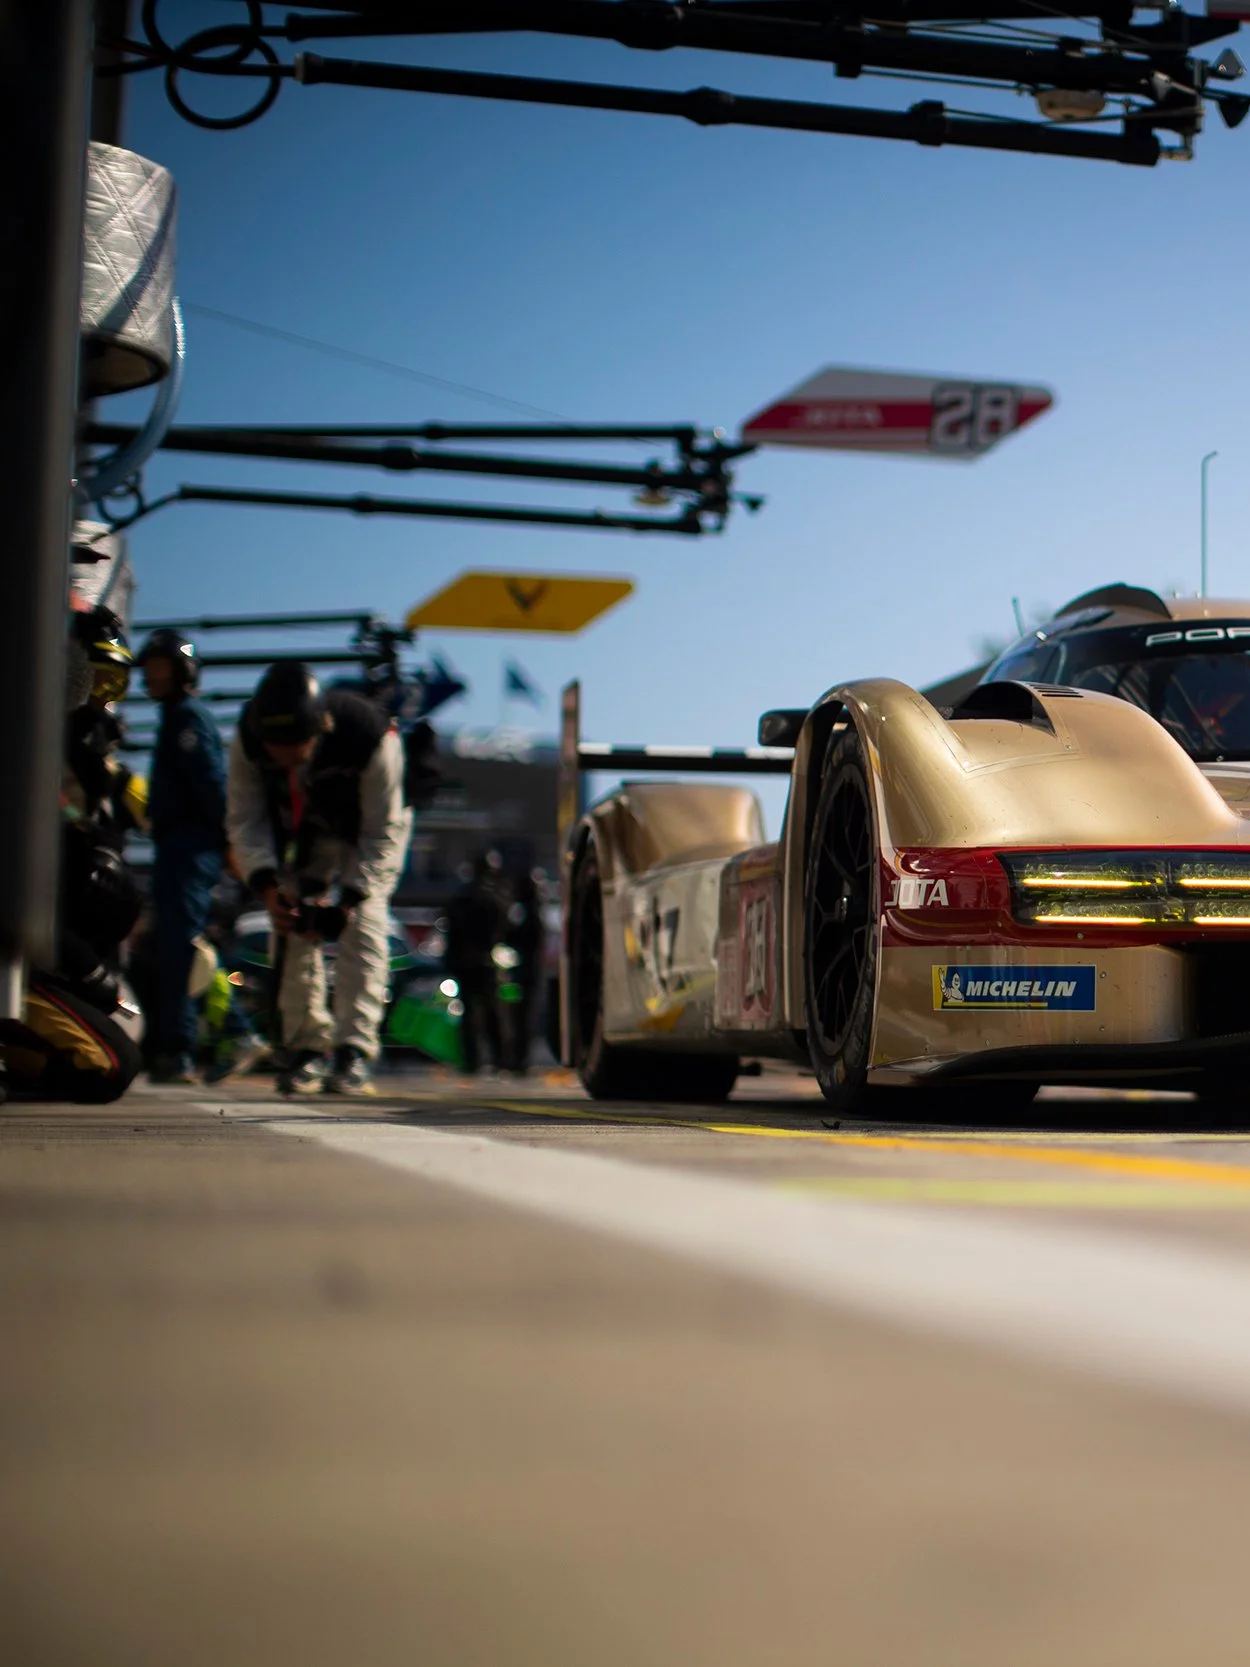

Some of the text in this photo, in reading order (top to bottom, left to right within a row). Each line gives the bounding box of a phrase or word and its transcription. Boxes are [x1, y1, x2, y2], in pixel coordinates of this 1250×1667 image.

[931, 381, 1020, 450] 28
[885, 878, 949, 909] JOTA
[966, 980, 1077, 998] MICHELIN
